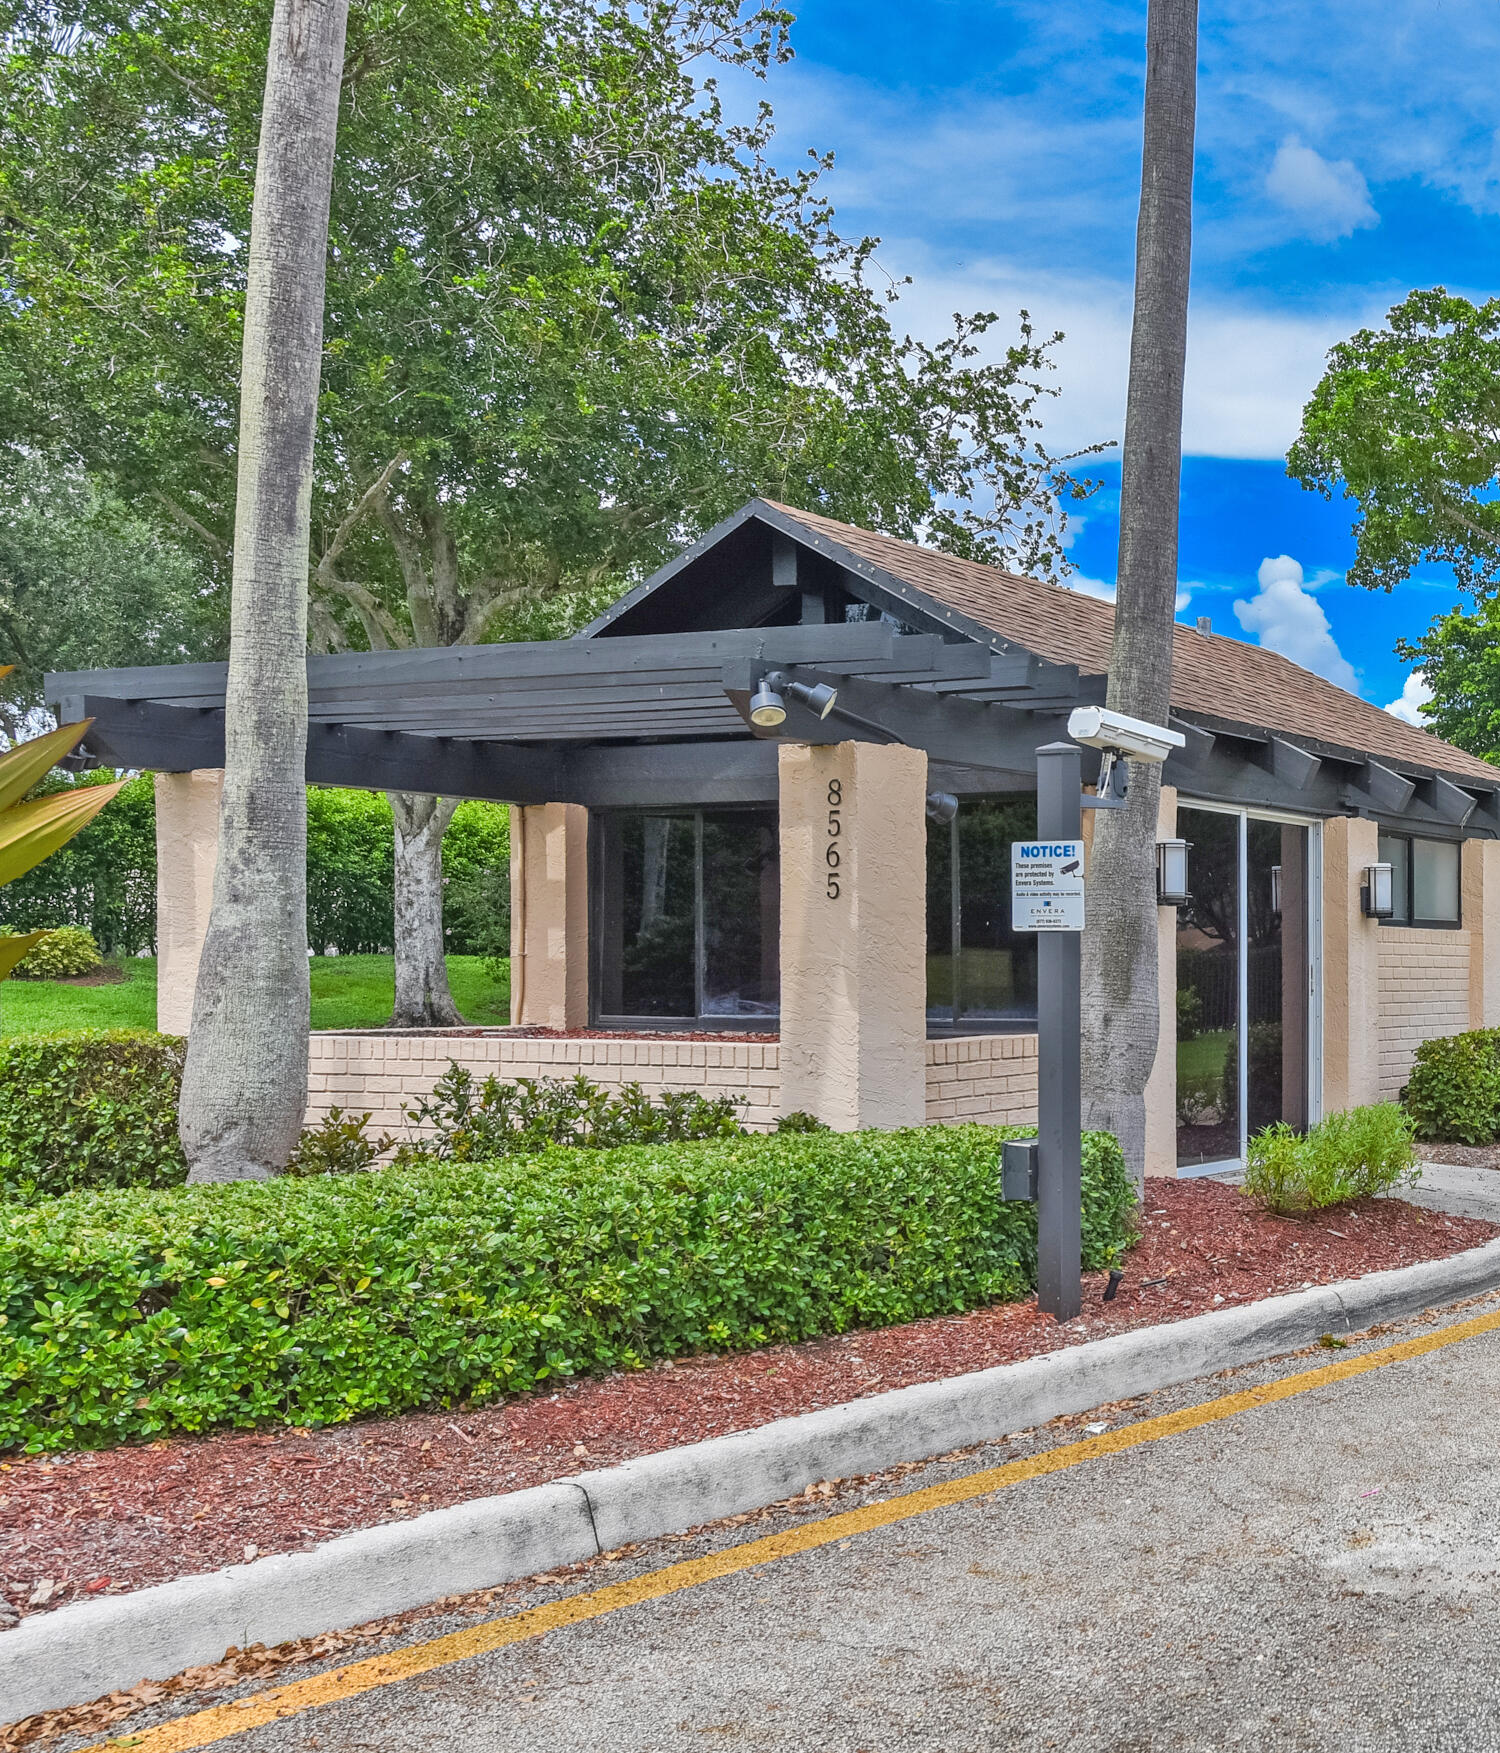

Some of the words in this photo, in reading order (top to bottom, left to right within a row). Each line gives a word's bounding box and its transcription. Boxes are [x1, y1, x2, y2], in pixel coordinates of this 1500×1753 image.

[826, 778, 842, 900] 8565
[1021, 845, 1076, 858] NOTICE!
[1030, 861, 1053, 870] premises
[1048, 871, 1055, 879] by
